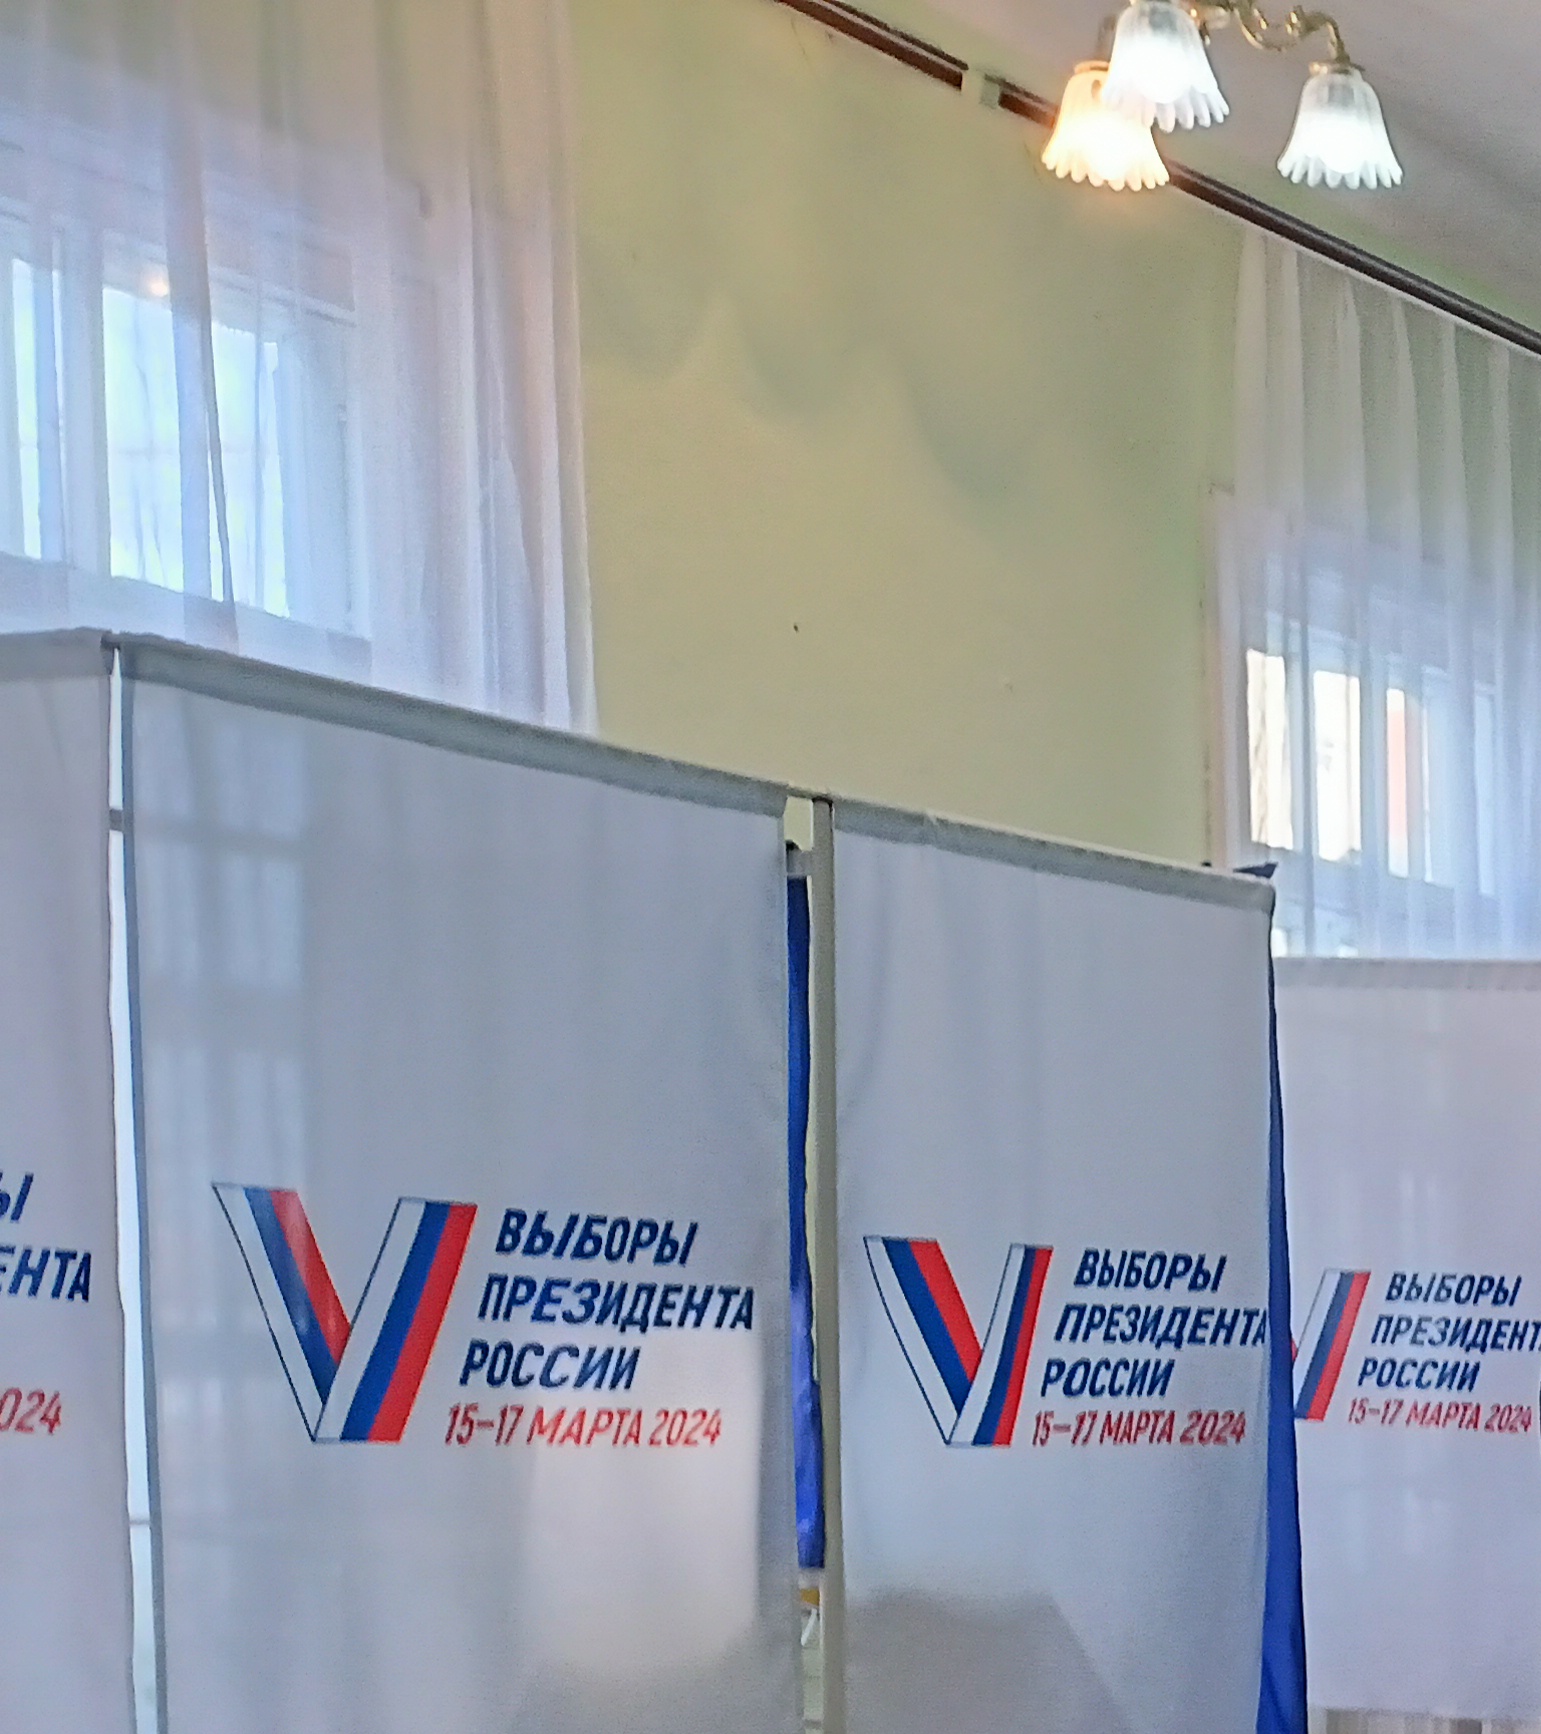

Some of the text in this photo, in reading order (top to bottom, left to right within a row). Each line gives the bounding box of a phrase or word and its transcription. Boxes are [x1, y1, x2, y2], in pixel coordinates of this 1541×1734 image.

[495, 1207, 699, 1267] ВЫБОРЫ
[1073, 1247, 1228, 1293] ВЫБОРЫ
[1385, 1271, 1523, 1307] ВЫБОРЫ
[478, 1272, 755, 1333] ПРЕЗИДЕНТА
[459, 1338, 641, 1391] РОССИИ
[1040, 1357, 1176, 1398] РОССИИ
[1357, 1356, 1481, 1392] РОССИИ
[0, 1387, 62, 1434] 024
[526, 1405, 643, 1447] МАРТА
[649, 1407, 723, 1447] 2024
[1099, 1409, 1176, 1446] МАРТА
[1179, 1408, 1247, 1447] 2024
[1404, 1399, 1481, 1432] МАРТА
[1484, 1403, 1533, 1433] 2024
